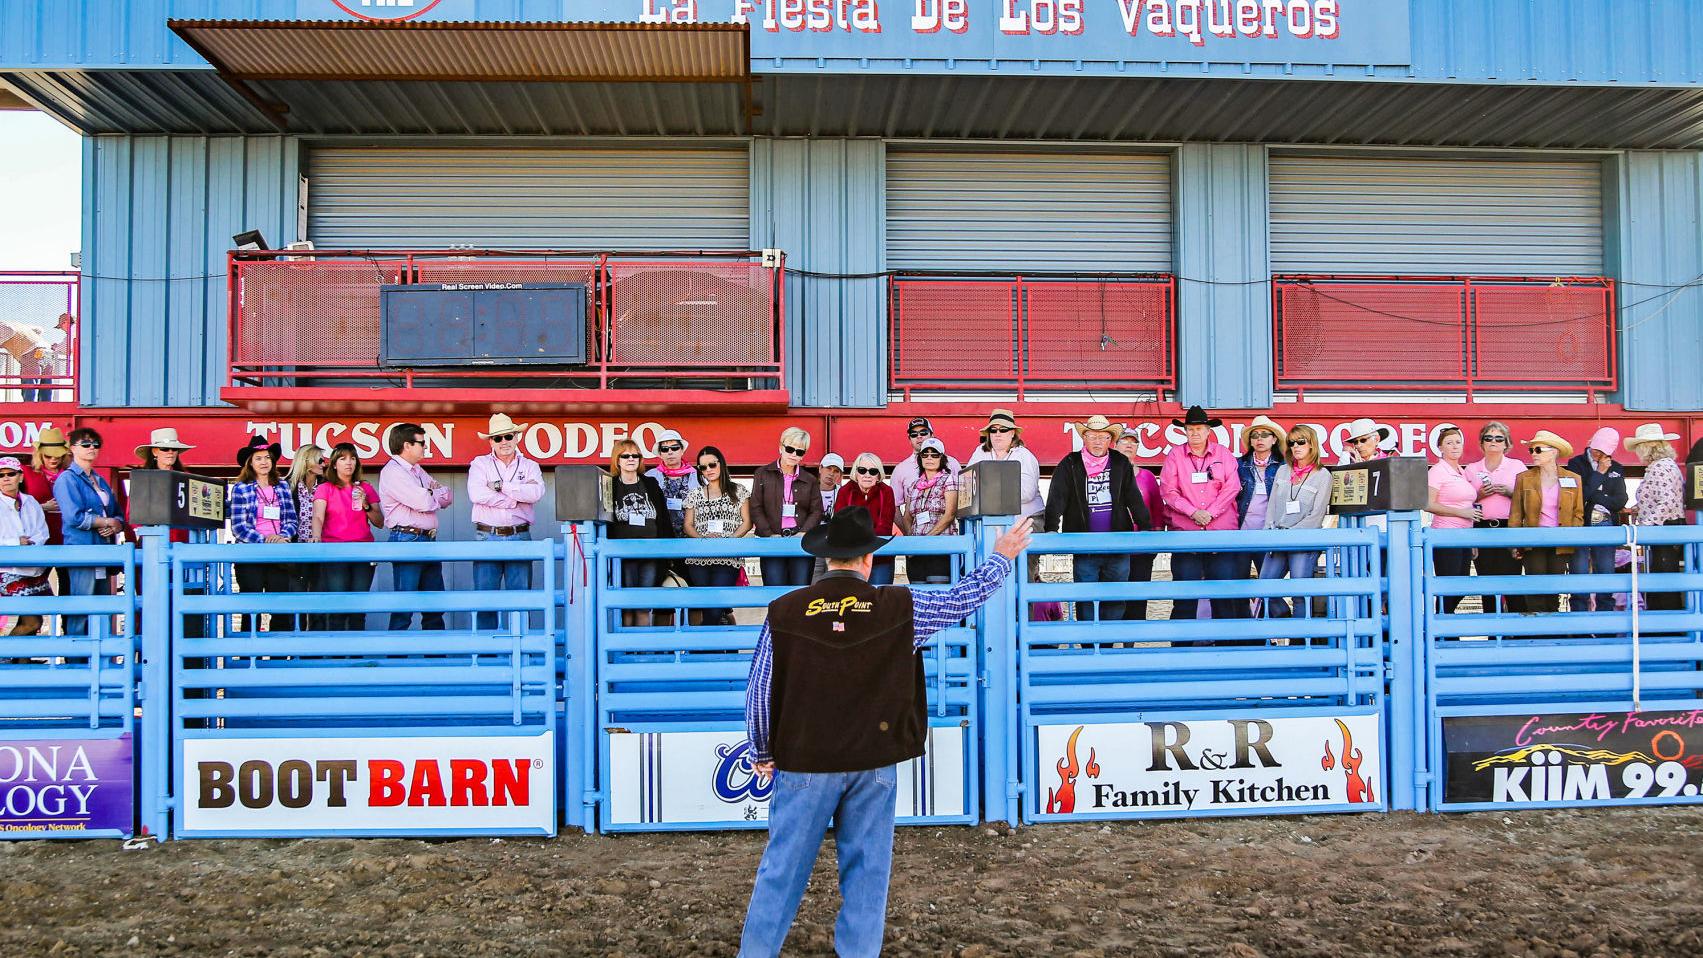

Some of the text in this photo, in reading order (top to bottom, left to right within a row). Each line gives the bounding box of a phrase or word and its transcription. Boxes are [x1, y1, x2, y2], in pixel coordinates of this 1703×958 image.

[1117, 0, 1340, 47] Vaqueros
[441, 283, 458, 291] Real
[459, 282, 484, 291] Screen
[246, 421, 669, 460] TUCSN ODEO
[177, 482, 187, 509] 5
[1372, 470, 1381, 497] 7
[1144, 718, 1282, 772] R&R
[1514, 713, 1619, 747] Country
[197, 758, 358, 810] BOOT
[1092, 777, 1331, 811] Family Kitchen
[48, 821, 86, 832] Network
